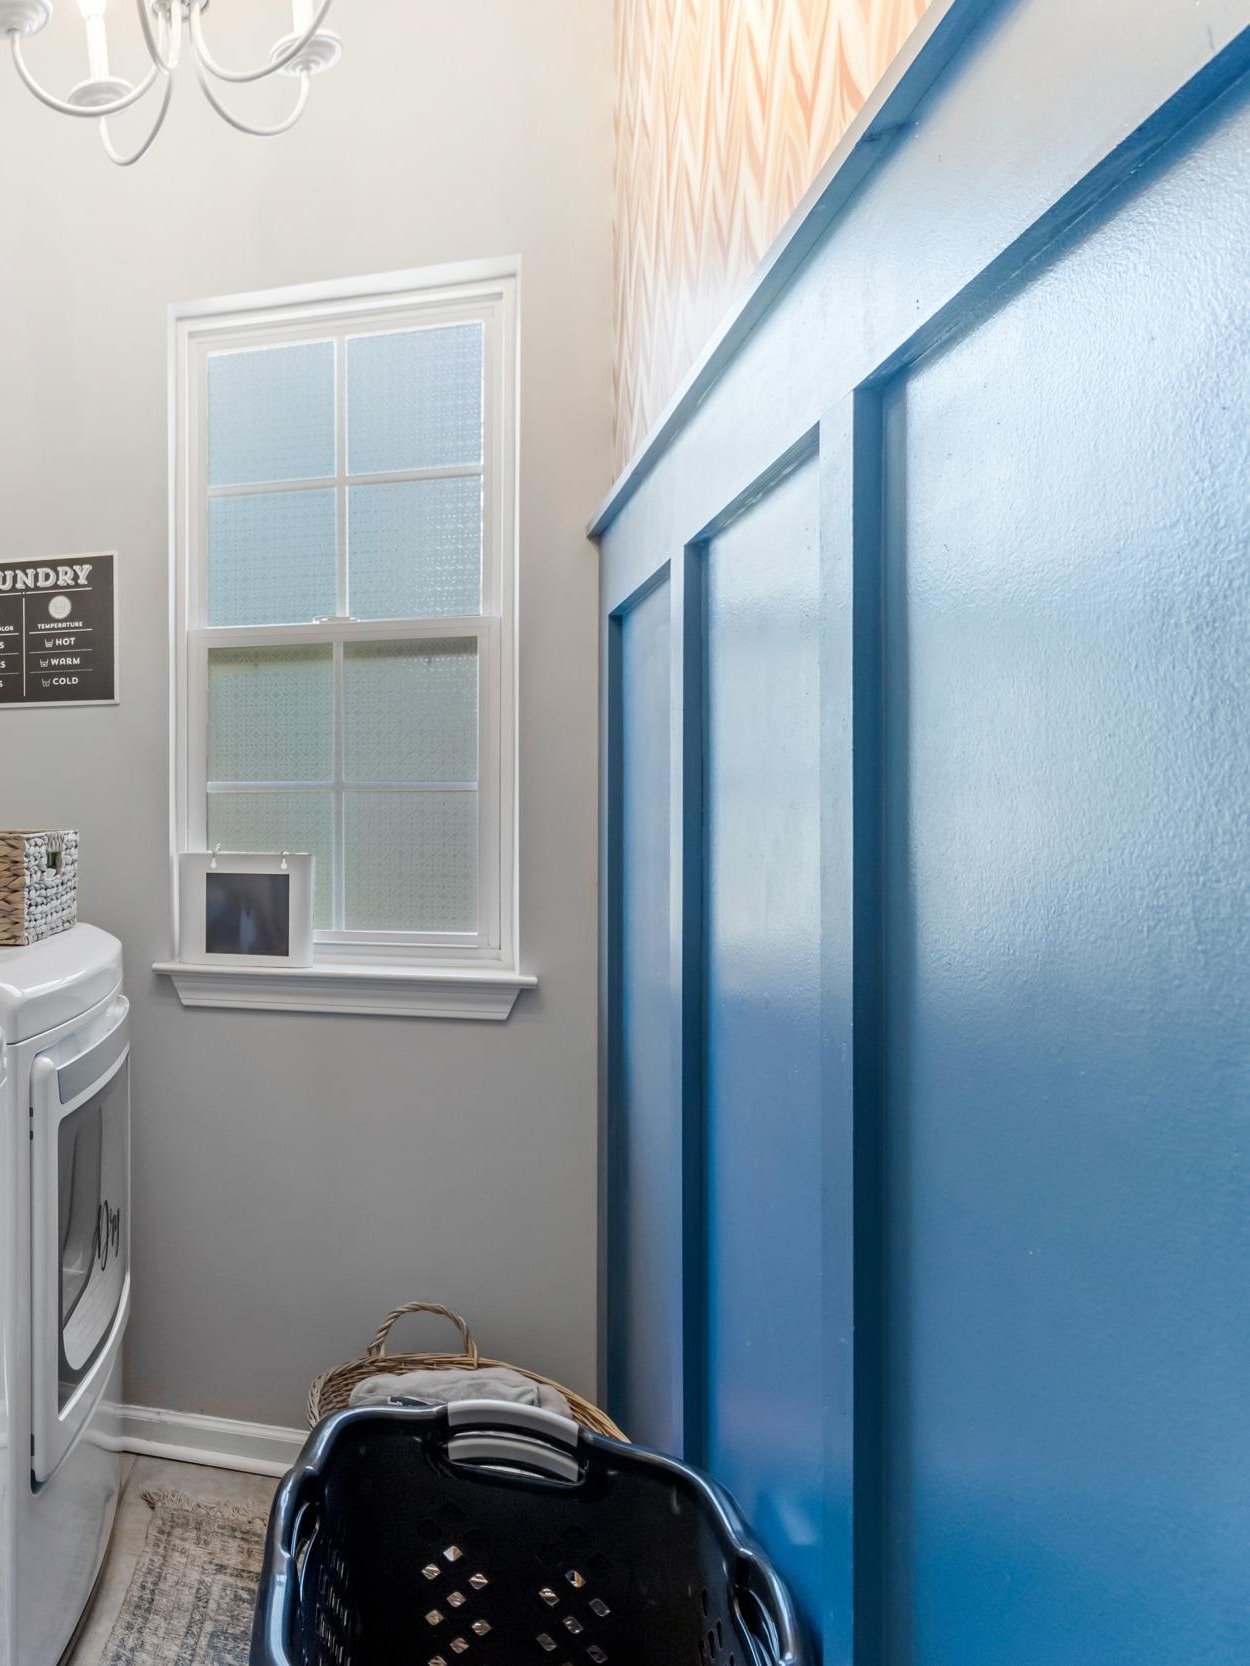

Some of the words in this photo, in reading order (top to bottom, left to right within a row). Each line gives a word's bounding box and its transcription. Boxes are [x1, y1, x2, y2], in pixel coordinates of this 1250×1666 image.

[37, 621, 83, 629] TEMPERATURE
[55, 637, 76, 646] HOT
[50, 657, 81, 666] WARM
[52, 677, 79, 685] COLD
[97, 1199, 120, 1272] Dry
